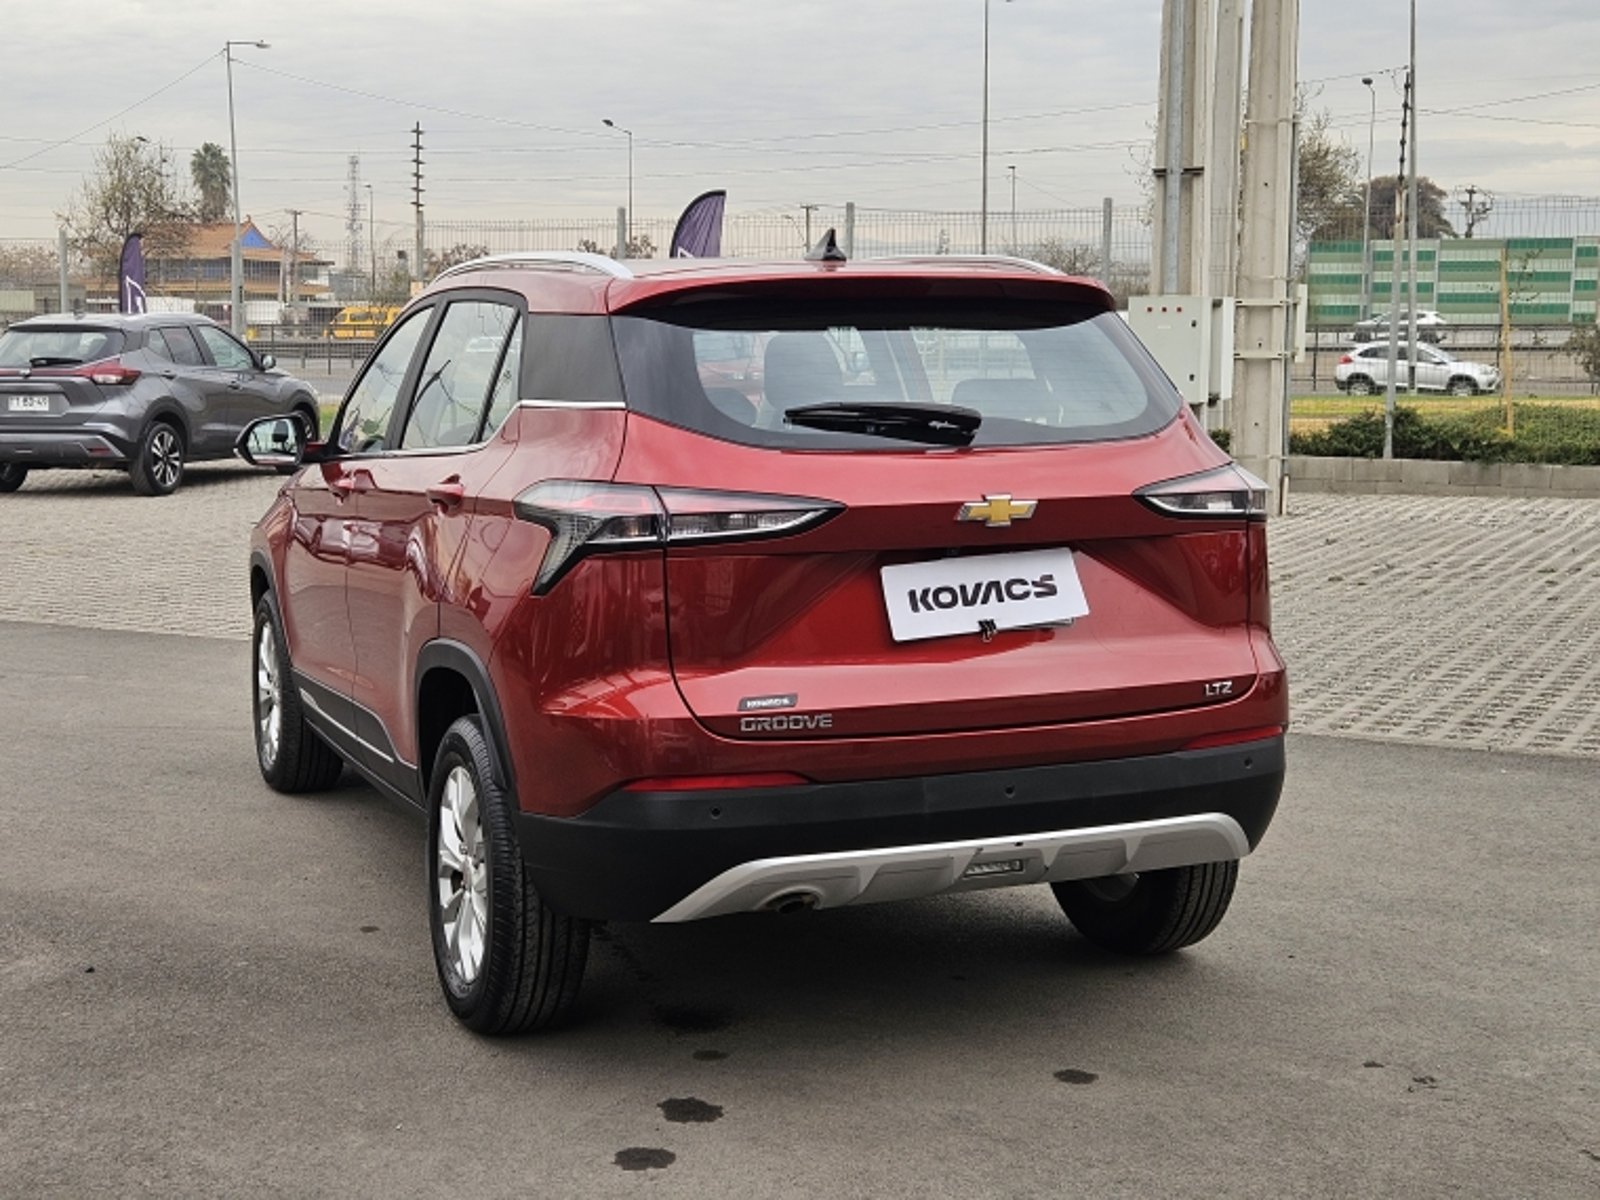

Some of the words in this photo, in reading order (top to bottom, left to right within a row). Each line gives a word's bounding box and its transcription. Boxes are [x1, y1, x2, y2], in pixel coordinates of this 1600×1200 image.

[908, 574, 1058, 613] KOVACS
[1205, 681, 1232, 696] LTZ
[741, 713, 833, 732] GROOVE
